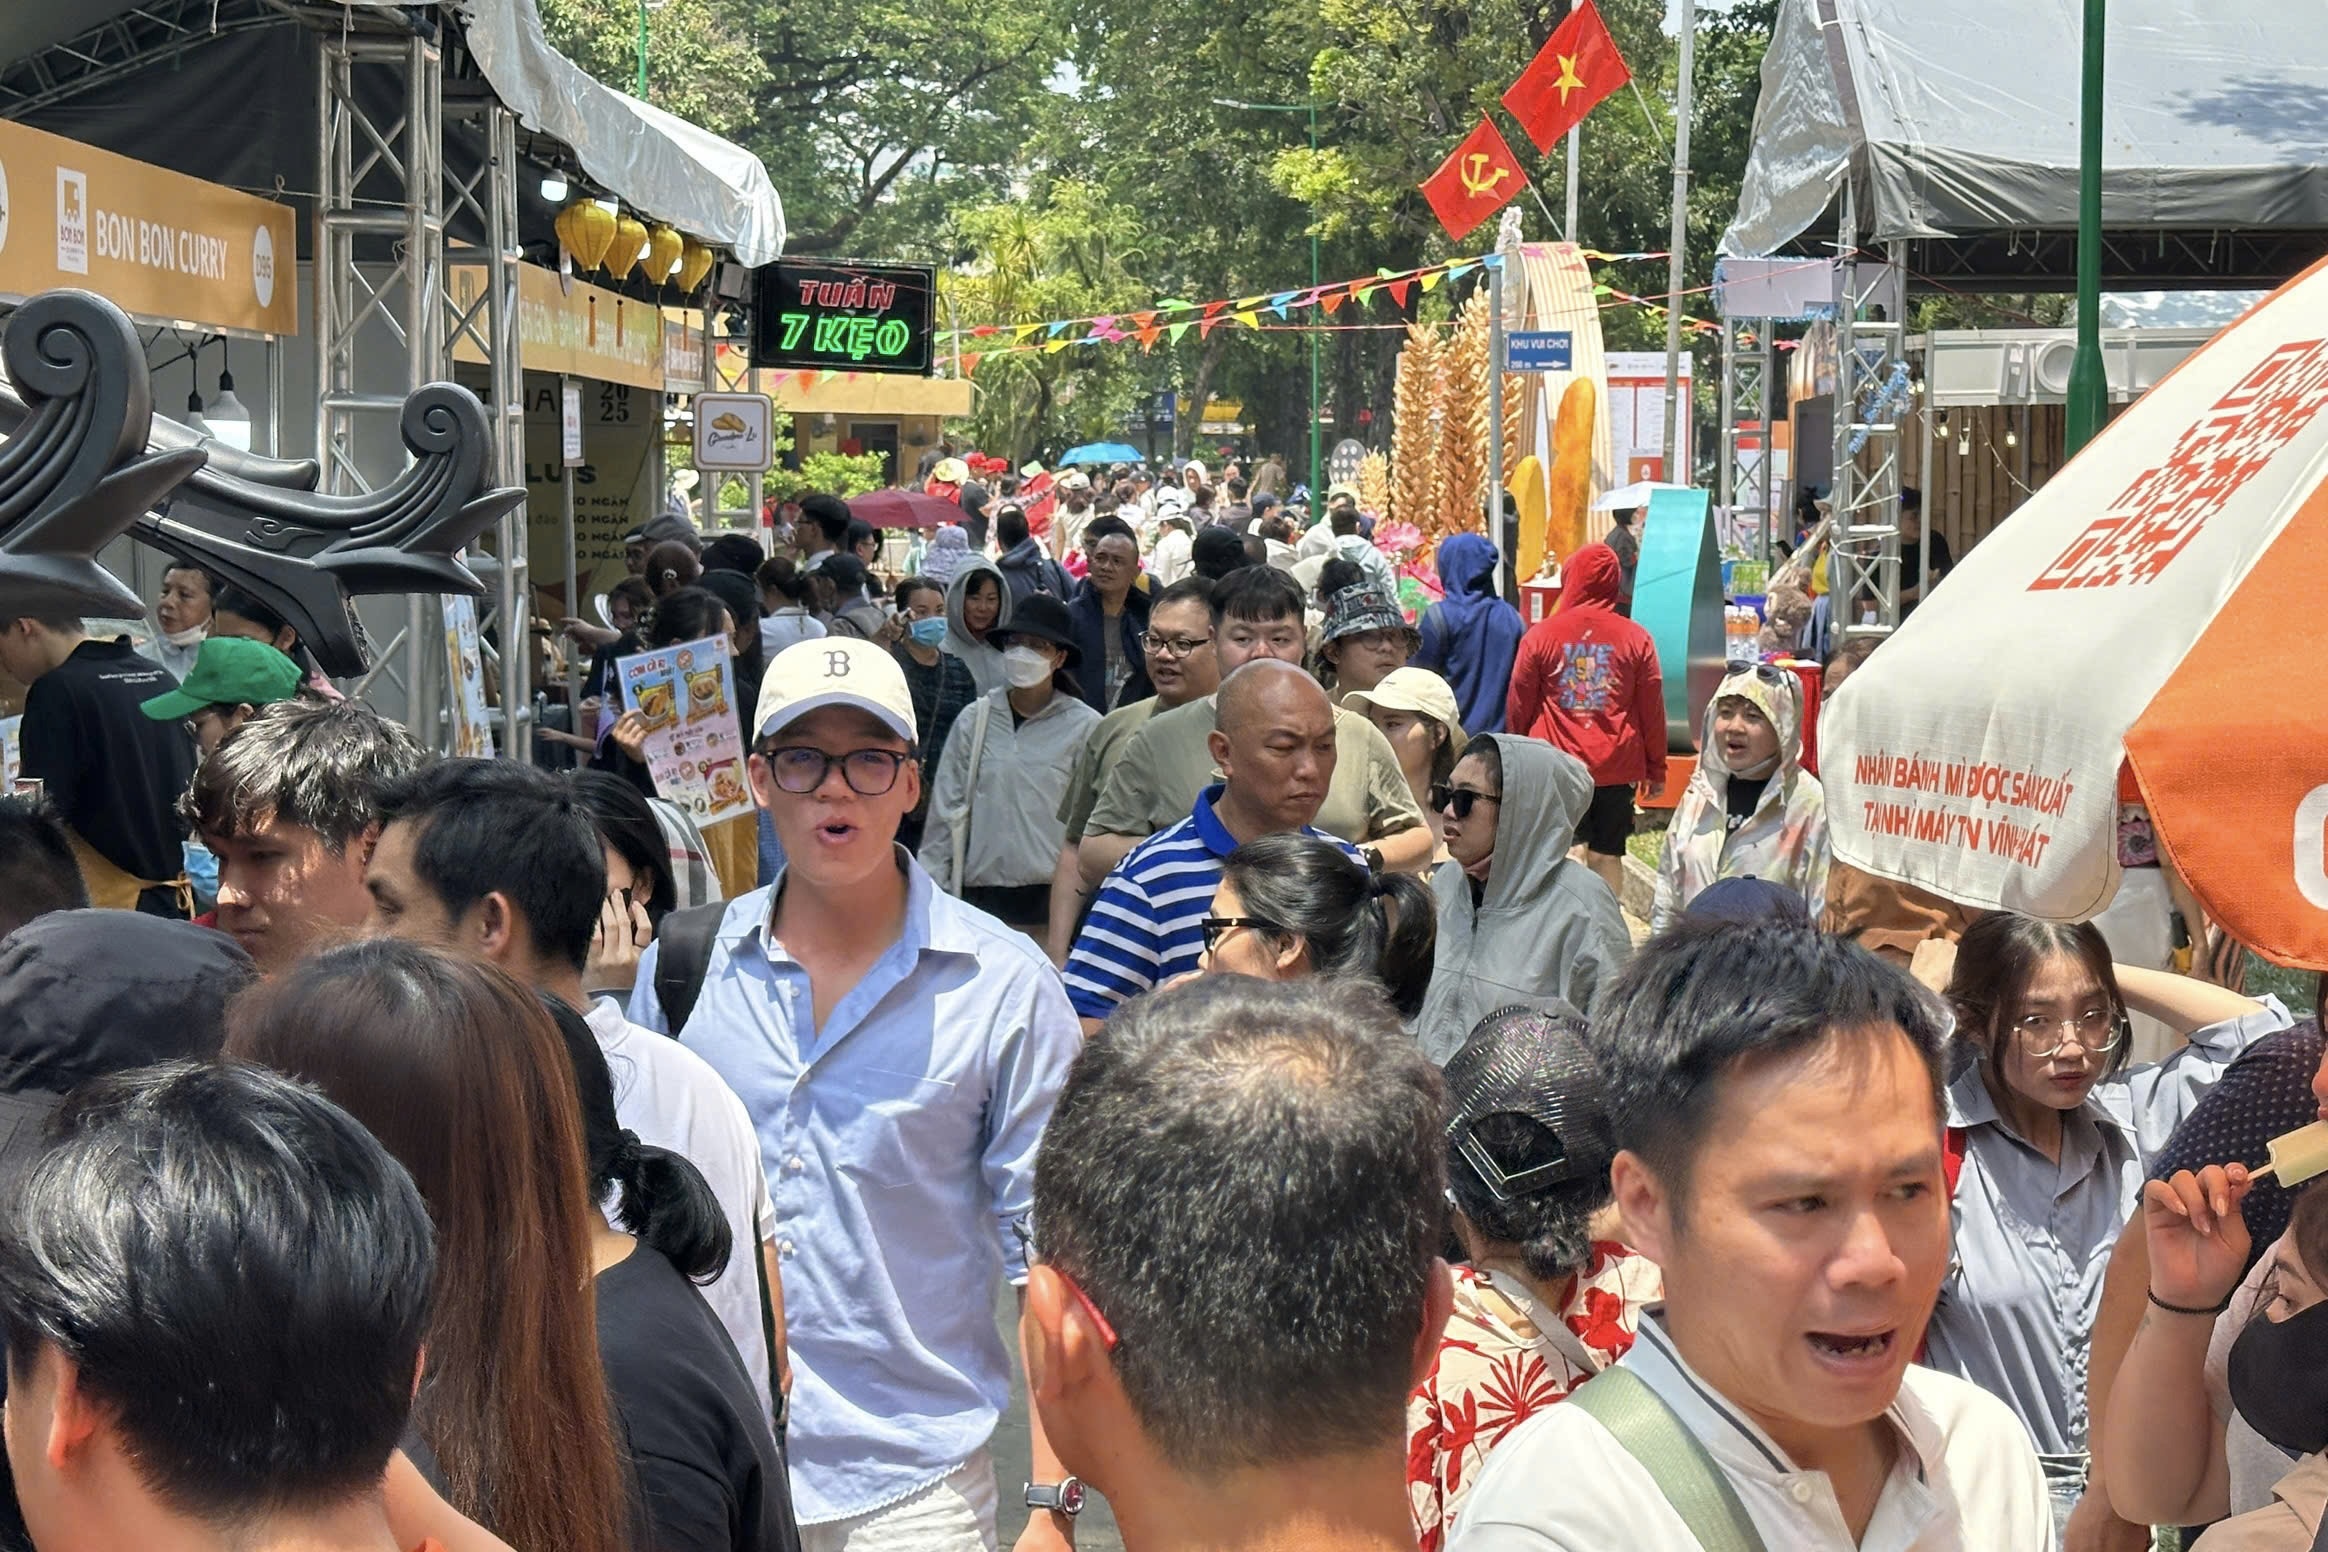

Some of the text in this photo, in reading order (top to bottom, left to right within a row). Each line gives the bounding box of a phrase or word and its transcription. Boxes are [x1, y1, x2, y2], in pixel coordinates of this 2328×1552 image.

[96, 209, 228, 281] BON BON CURRY
[781, 313, 910, 360] 7 KẸO
[1510, 338, 1529, 349] KHU
[1530, 338, 1545, 349] VUI
[601, 400, 629, 422] 25
[823, 650, 851, 677] B
[1855, 748, 1893, 786] NHÂN
[1893, 751, 1941, 793] BÁNH
[1945, 757, 1966, 796] MÌ
[1914, 804, 1956, 845] MÁY
